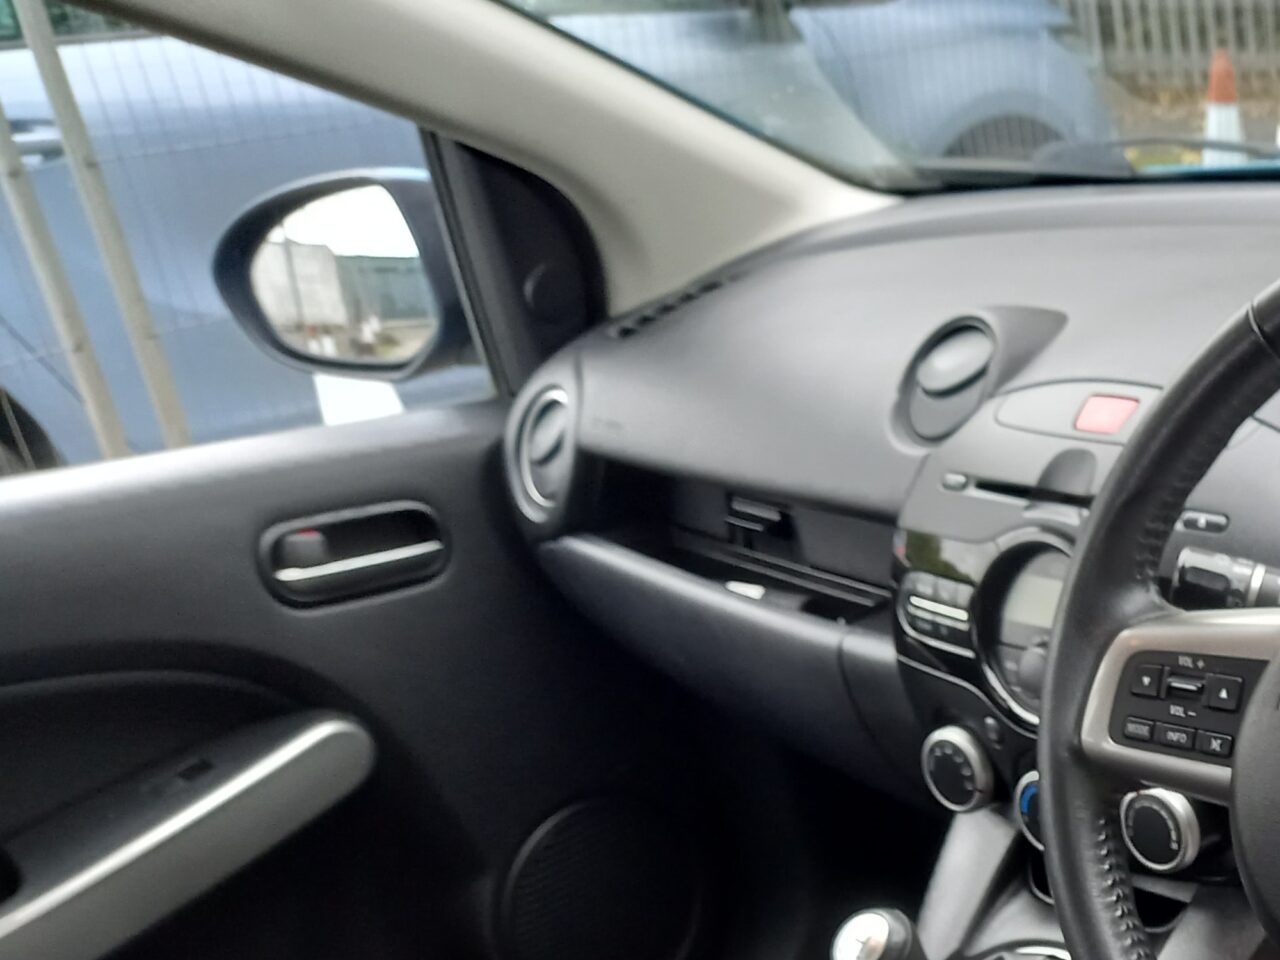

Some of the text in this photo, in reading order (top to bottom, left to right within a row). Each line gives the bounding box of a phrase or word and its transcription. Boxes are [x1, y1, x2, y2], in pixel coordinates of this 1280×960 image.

[1178, 655, 1194, 669] VOL
[1169, 704, 1186, 718] VOL
[1166, 730, 1188, 744] INFO
